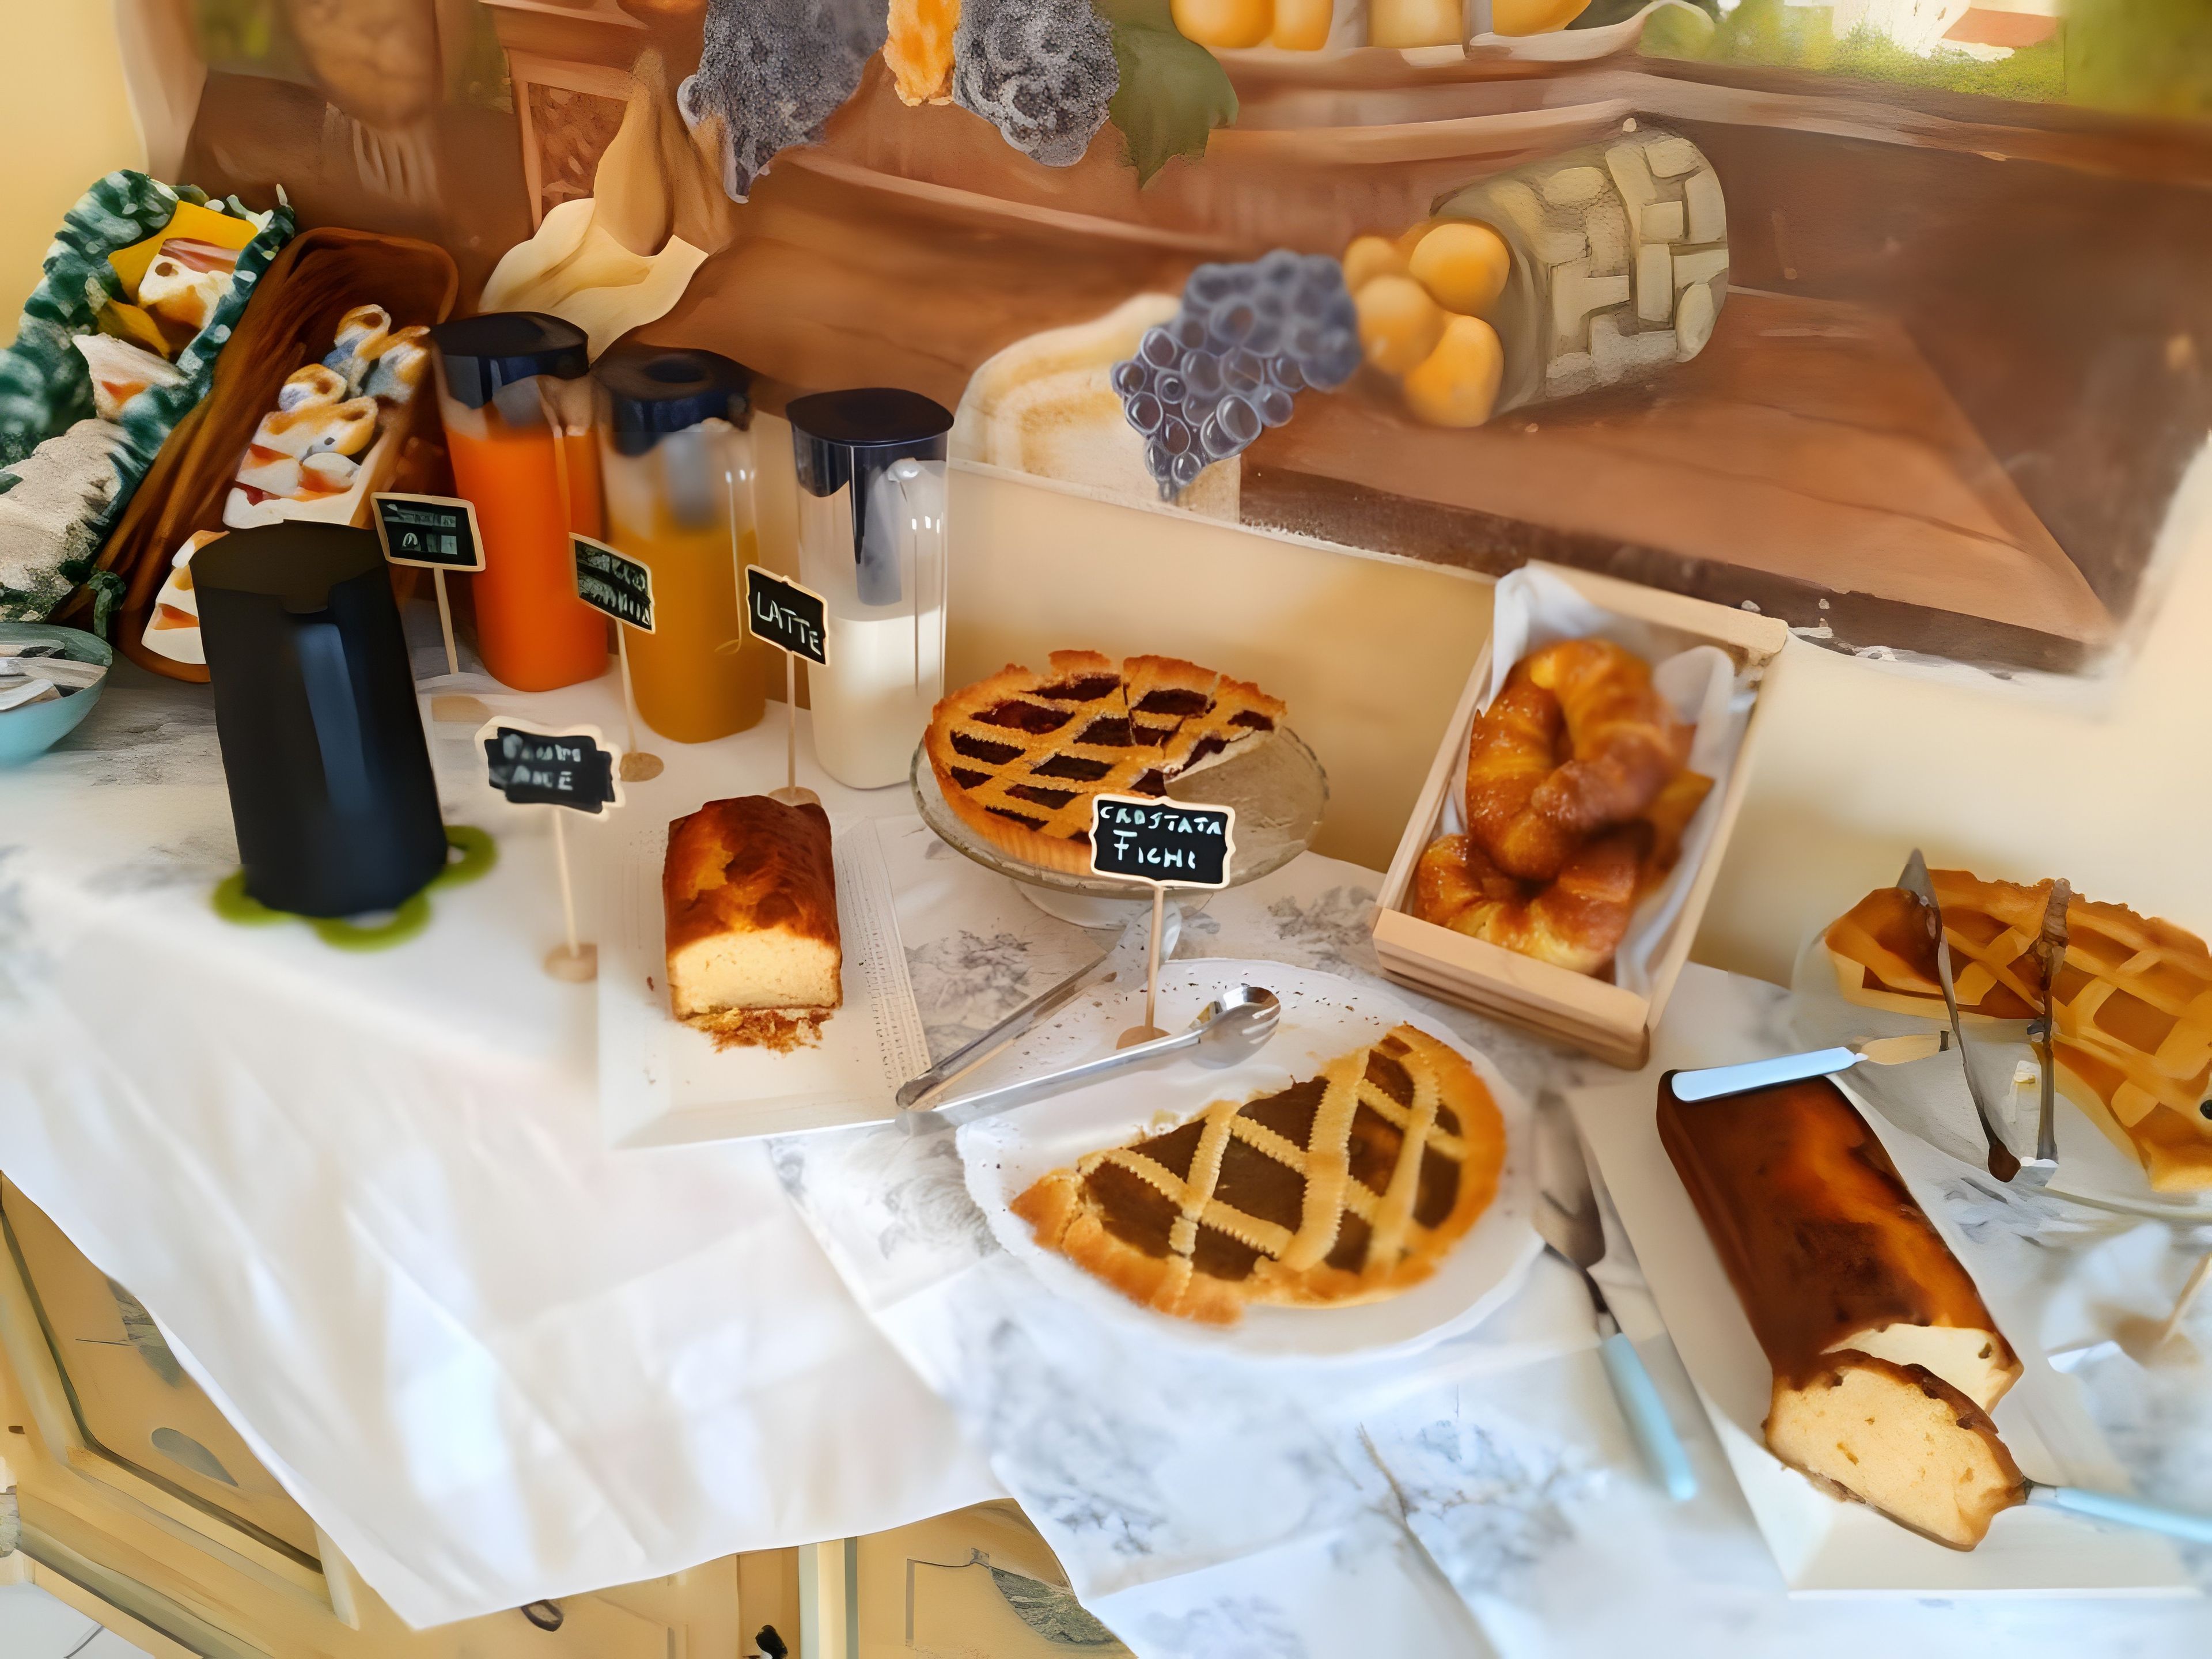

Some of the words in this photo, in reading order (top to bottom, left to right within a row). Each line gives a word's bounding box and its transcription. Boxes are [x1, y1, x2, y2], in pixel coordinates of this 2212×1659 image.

[757, 591, 821, 656] LATTE
[1100, 806, 1222, 835] CROSTATA
[1112, 829, 1196, 870] FICHI
